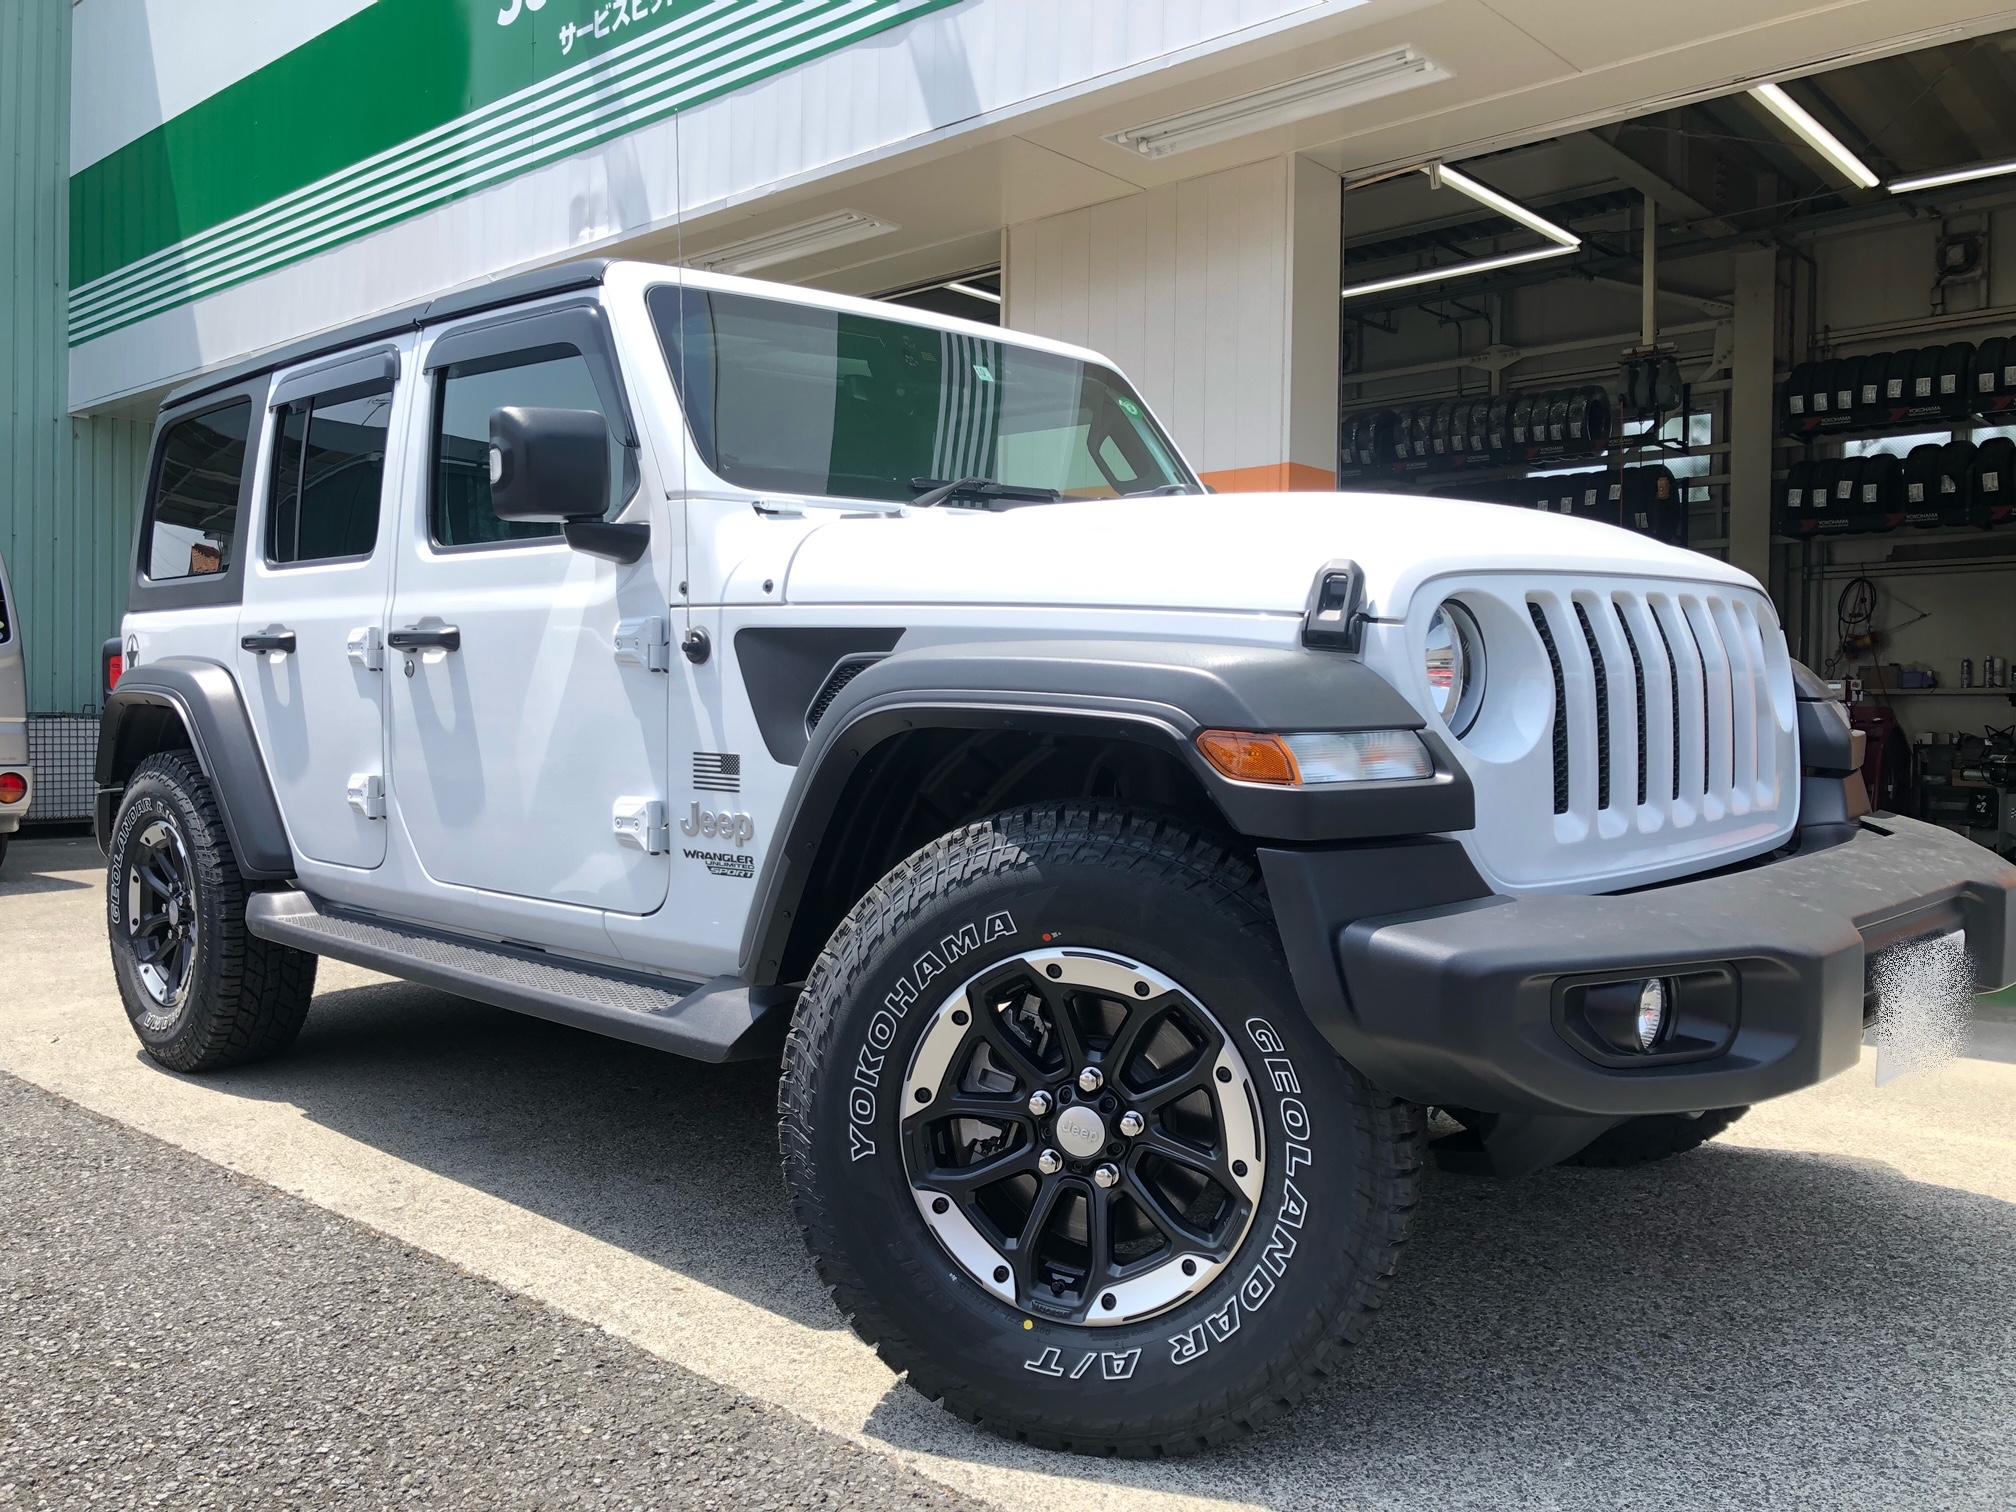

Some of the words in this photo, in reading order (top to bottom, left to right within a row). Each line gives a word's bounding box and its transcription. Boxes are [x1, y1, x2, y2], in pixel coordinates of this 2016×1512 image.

[680, 800, 755, 848] Jeep
[110, 796, 152, 925] GEOLANDAR
[682, 848, 754, 865] WRANGLER
[705, 860, 755, 870] UNLIMITED
[709, 867, 754, 878] SPORT
[850, 909, 1018, 1161] YOKOHAMA
[1061, 1119, 1099, 1143] Jeep
[1169, 1015, 1312, 1365] GEOLANDAR
[1023, 1345, 1143, 1382] A/T
